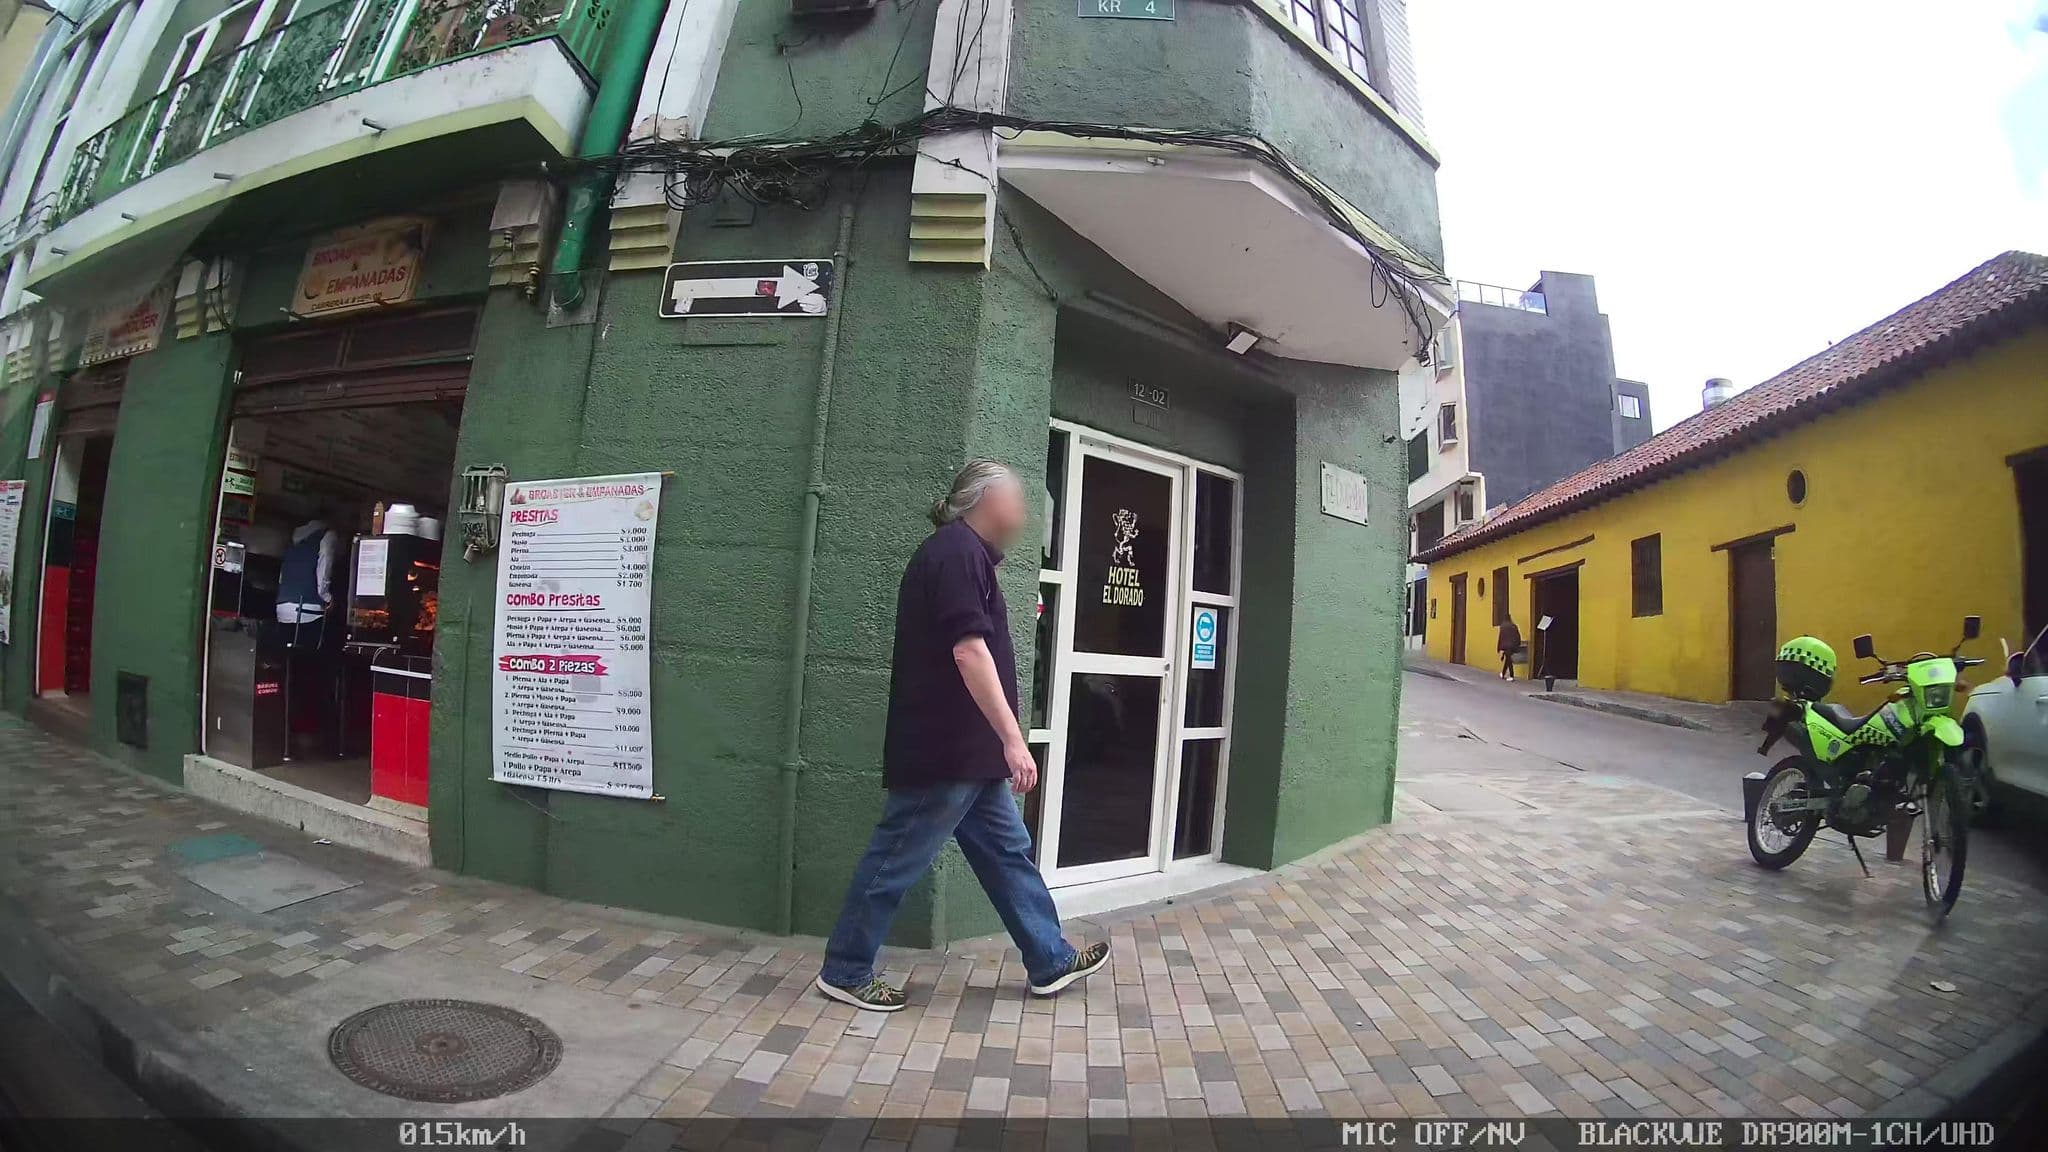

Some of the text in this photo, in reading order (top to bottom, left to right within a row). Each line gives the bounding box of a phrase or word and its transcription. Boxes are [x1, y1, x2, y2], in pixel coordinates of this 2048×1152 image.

[1098, 0, 1156, 14] KR 4
[326, 266, 406, 294] EMPANADAS
[586, 484, 644, 498] EMPANADAS
[510, 509, 558, 523] PRESITAS
[1108, 566, 1140, 587] HOTEL
[549, 593, 601, 606] Presitas
[1102, 584, 1144, 607] EL DORADO
[549, 660, 556, 671] 2
[559, 660, 595, 674] Piezas
[509, 762, 526, 770] Pollo
[534, 764, 552, 773] Papa
[560, 768, 582, 776] Arepa
